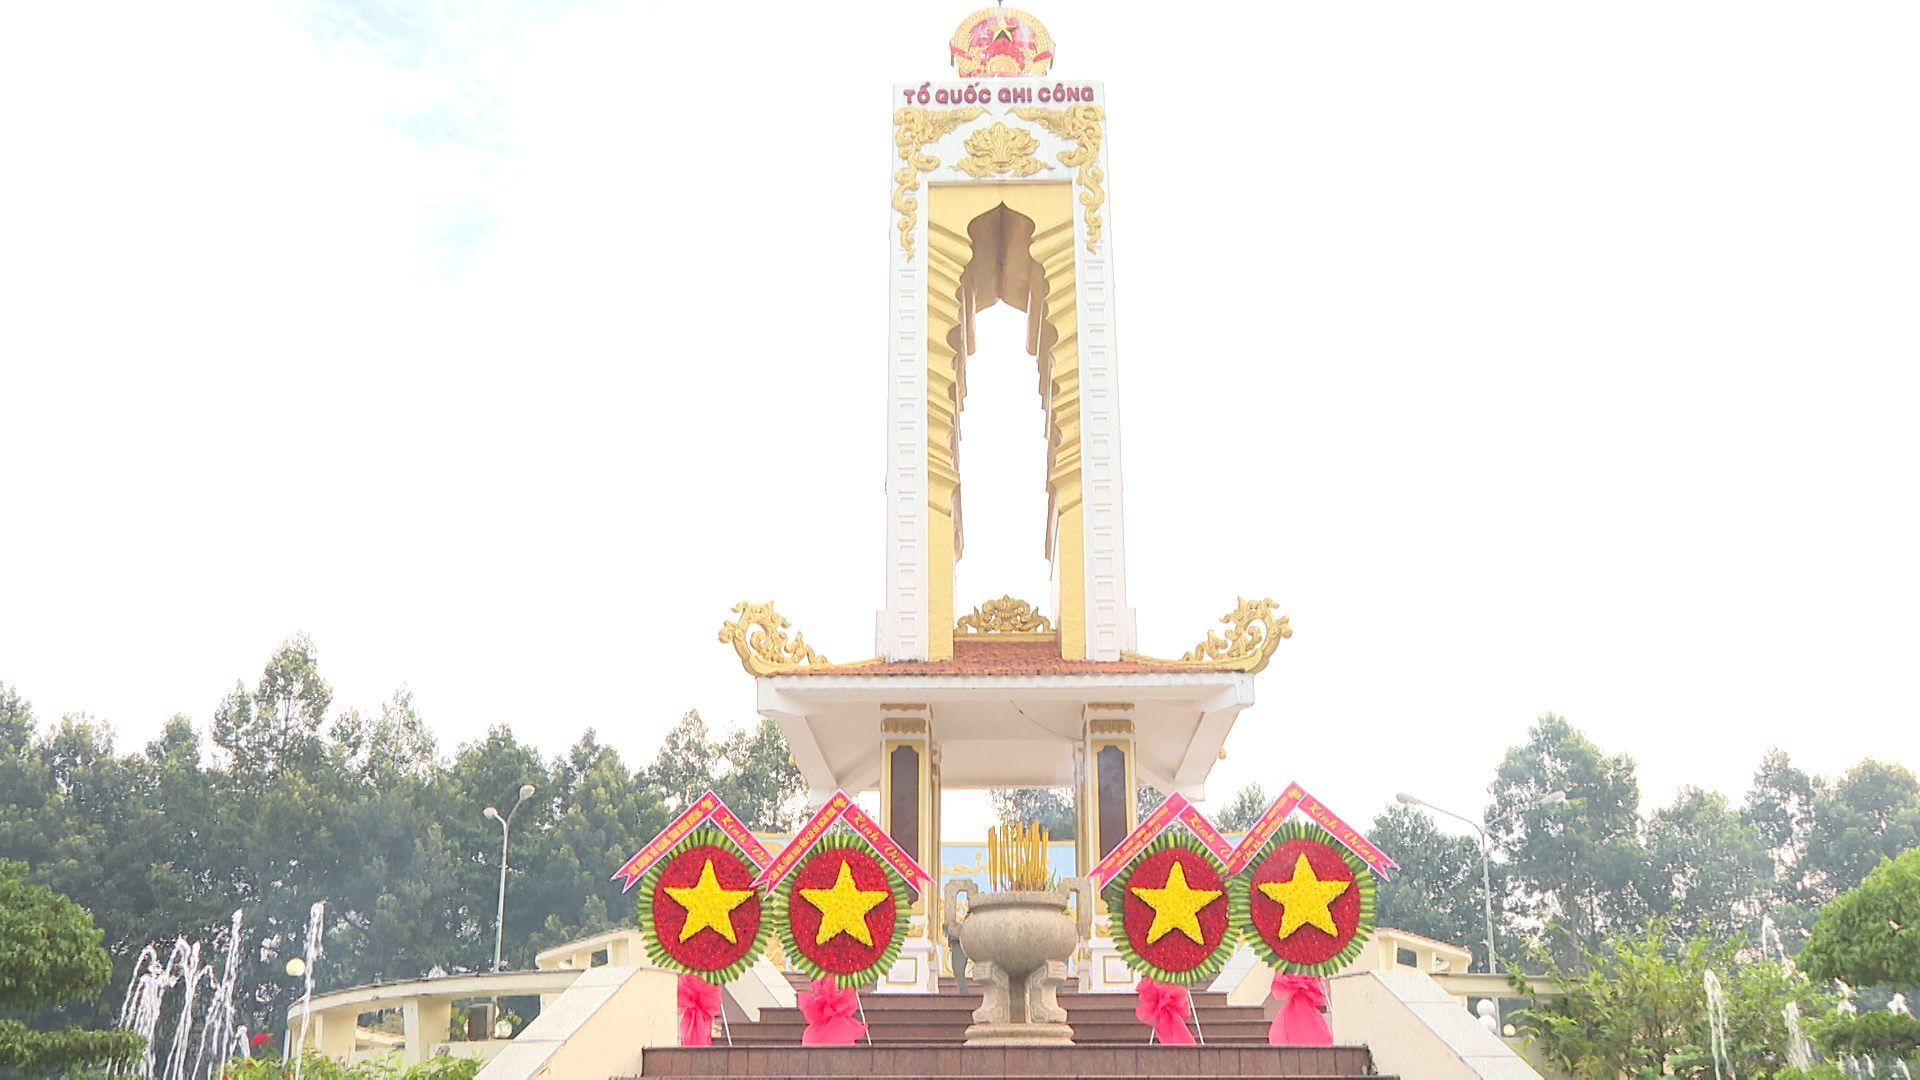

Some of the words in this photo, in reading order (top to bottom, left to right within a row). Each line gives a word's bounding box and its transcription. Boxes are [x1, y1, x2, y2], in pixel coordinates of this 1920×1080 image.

[935, 81, 992, 105] QUỐC
[997, 87, 1033, 104] GHI
[1038, 83, 1094, 103] CÔNG
